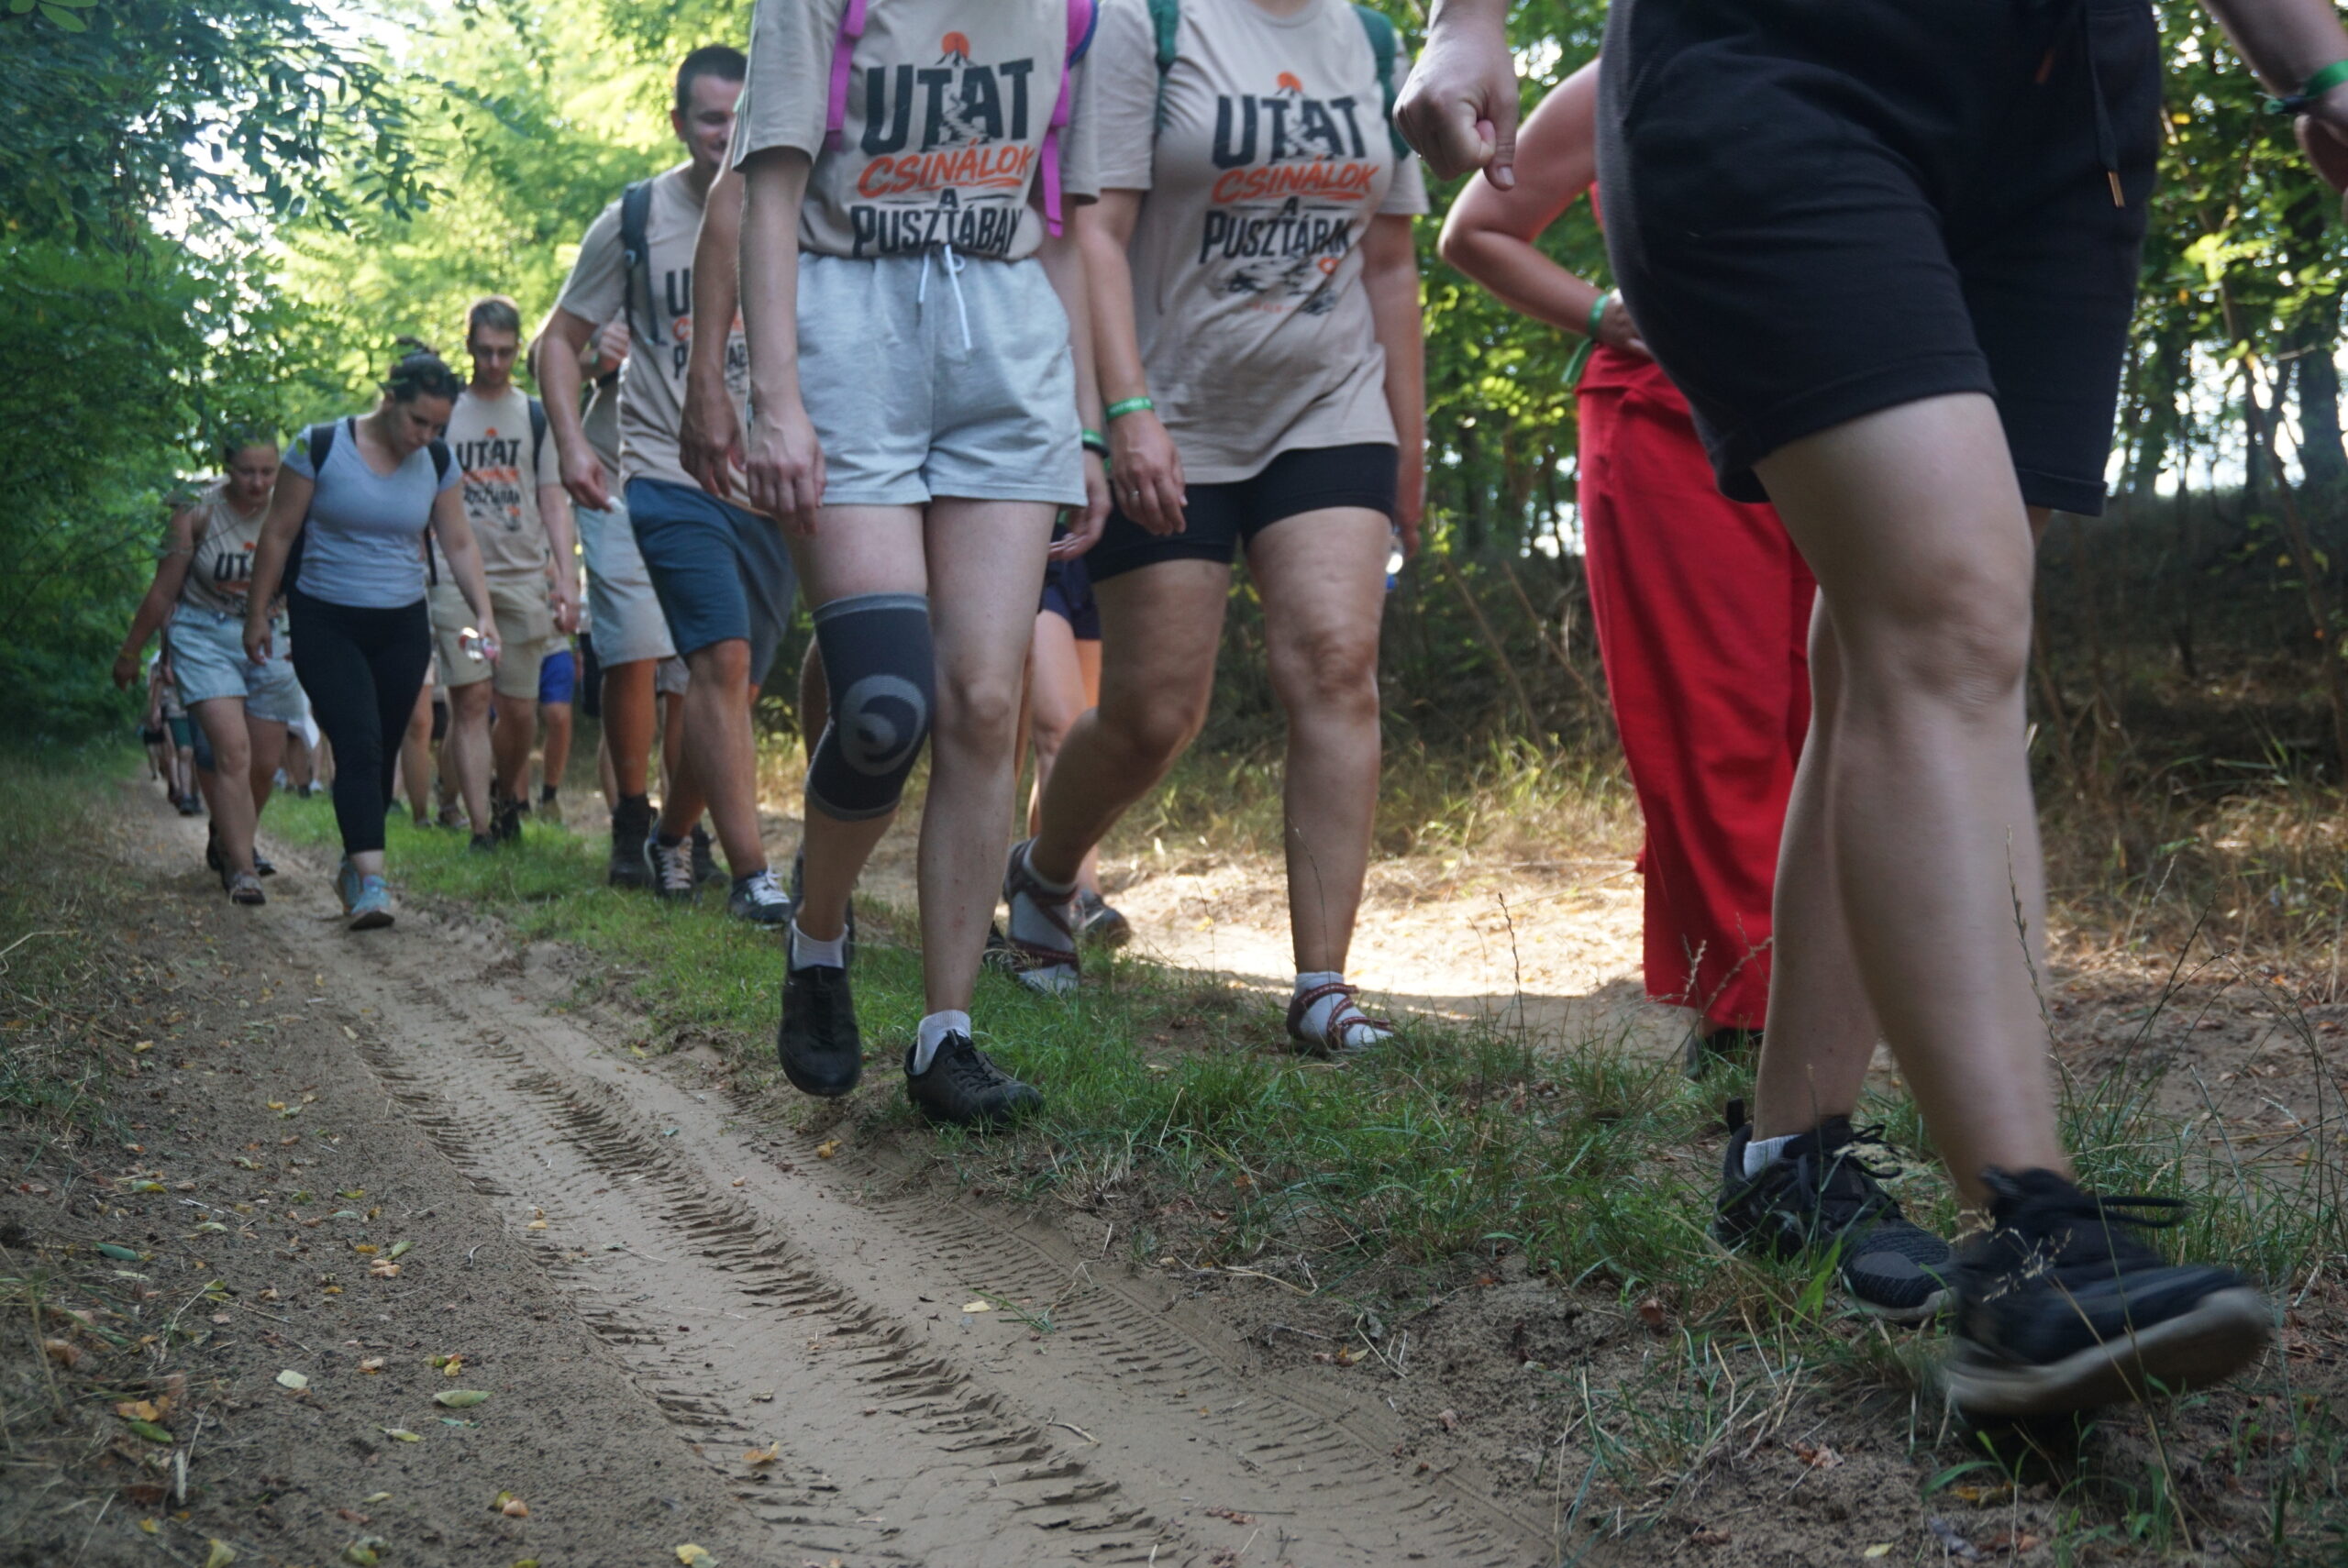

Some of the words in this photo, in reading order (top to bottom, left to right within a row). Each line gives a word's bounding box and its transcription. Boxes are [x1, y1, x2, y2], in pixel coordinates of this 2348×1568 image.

[860, 58, 1034, 155] UTAT
[1213, 95, 1365, 169] UTAT
[940, 188, 958, 208] A
[1211, 154, 1379, 204] CSINÁLOK
[1280, 196, 1299, 215] A
[457, 438, 521, 471] UTAT
